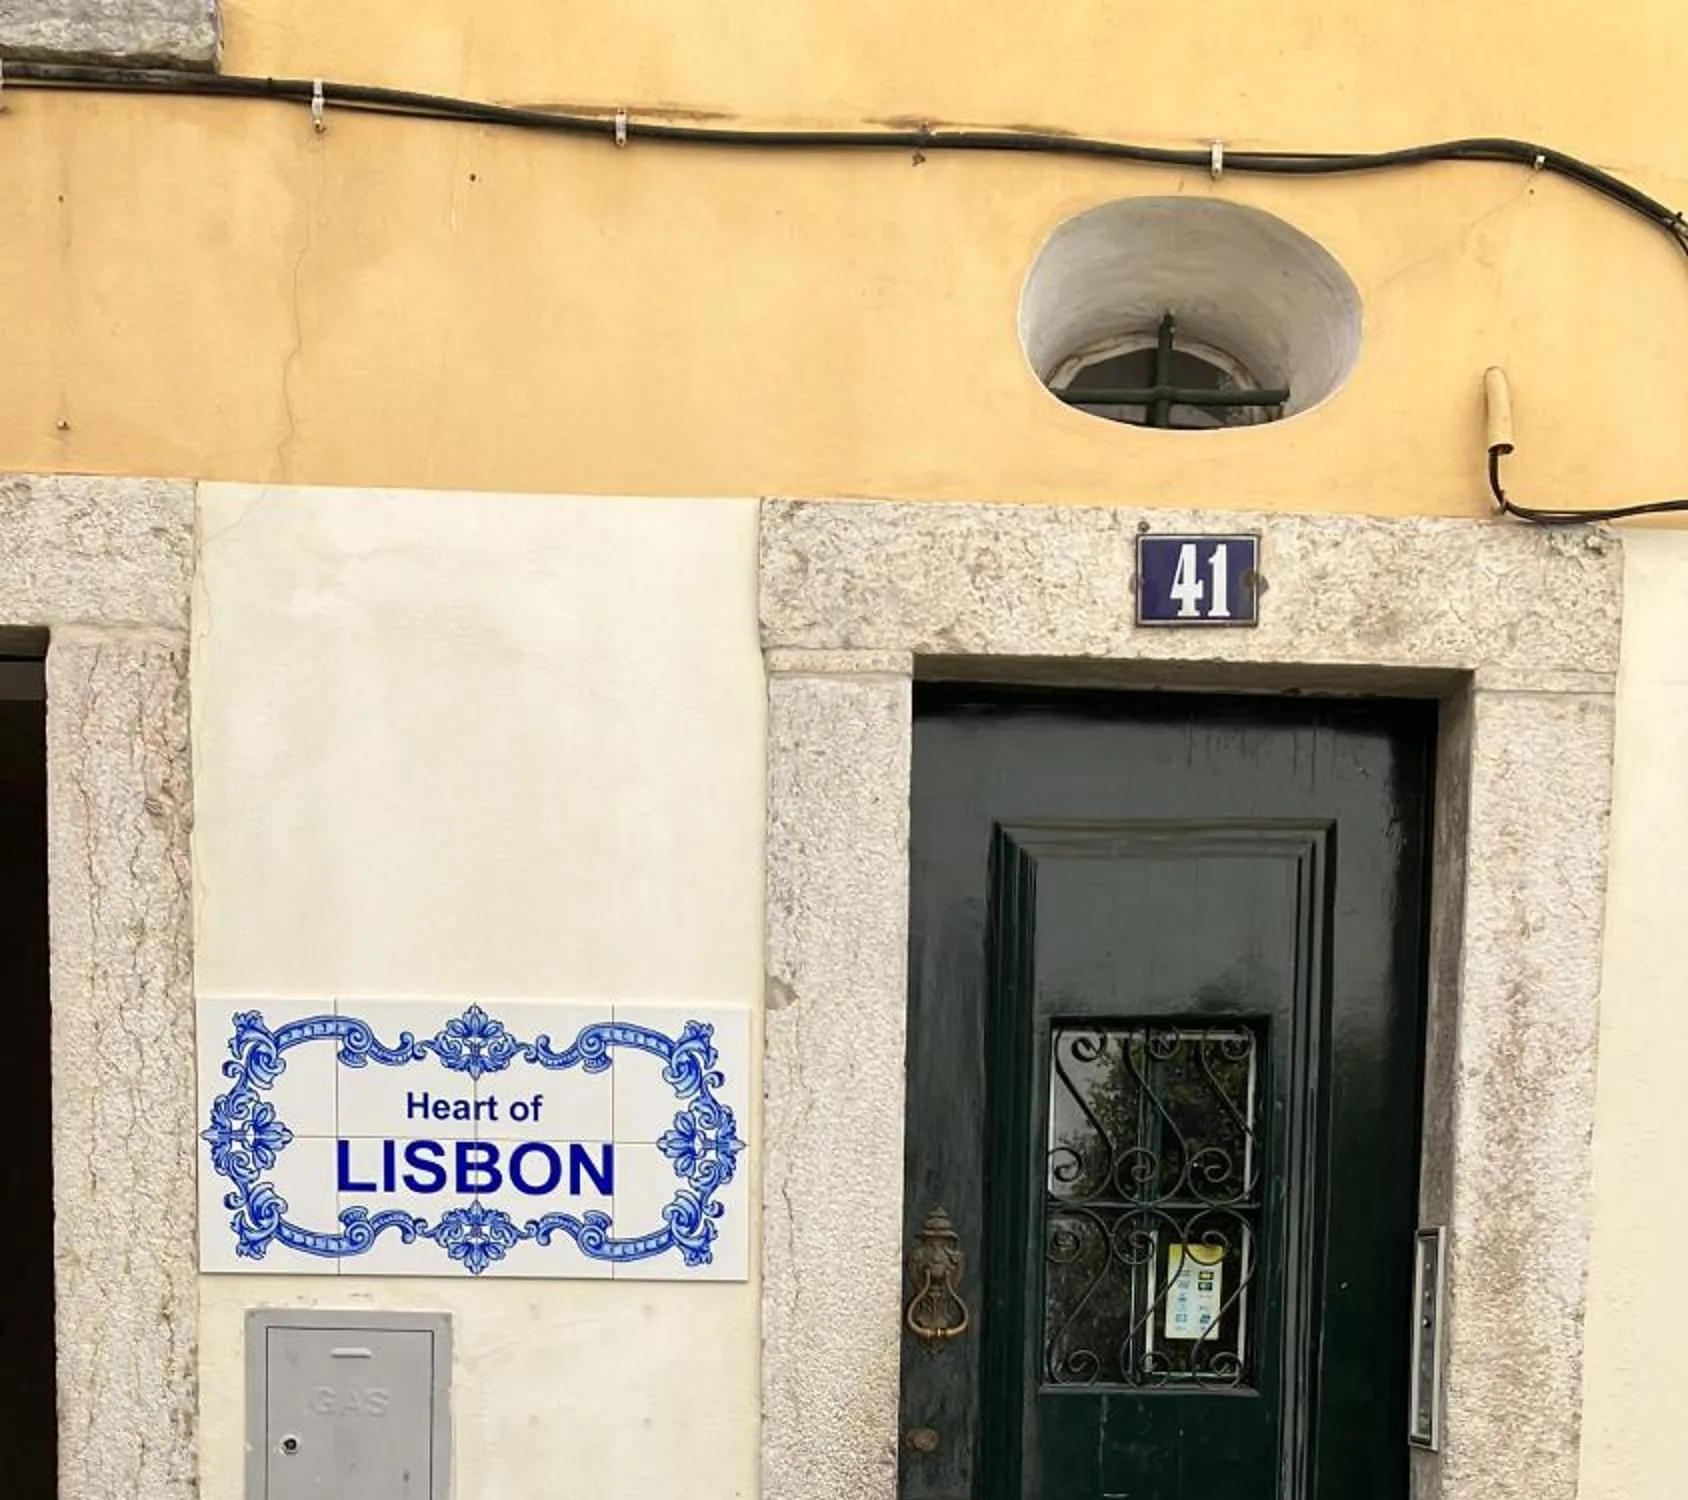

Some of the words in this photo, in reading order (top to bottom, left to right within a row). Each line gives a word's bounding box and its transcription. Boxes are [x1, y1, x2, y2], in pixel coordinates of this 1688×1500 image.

[1169, 543, 1231, 617] 41
[406, 1091, 498, 1121] Heart
[509, 1093, 544, 1122] of
[337, 1139, 614, 1197] LISBON
[309, 1385, 390, 1417] GAS
